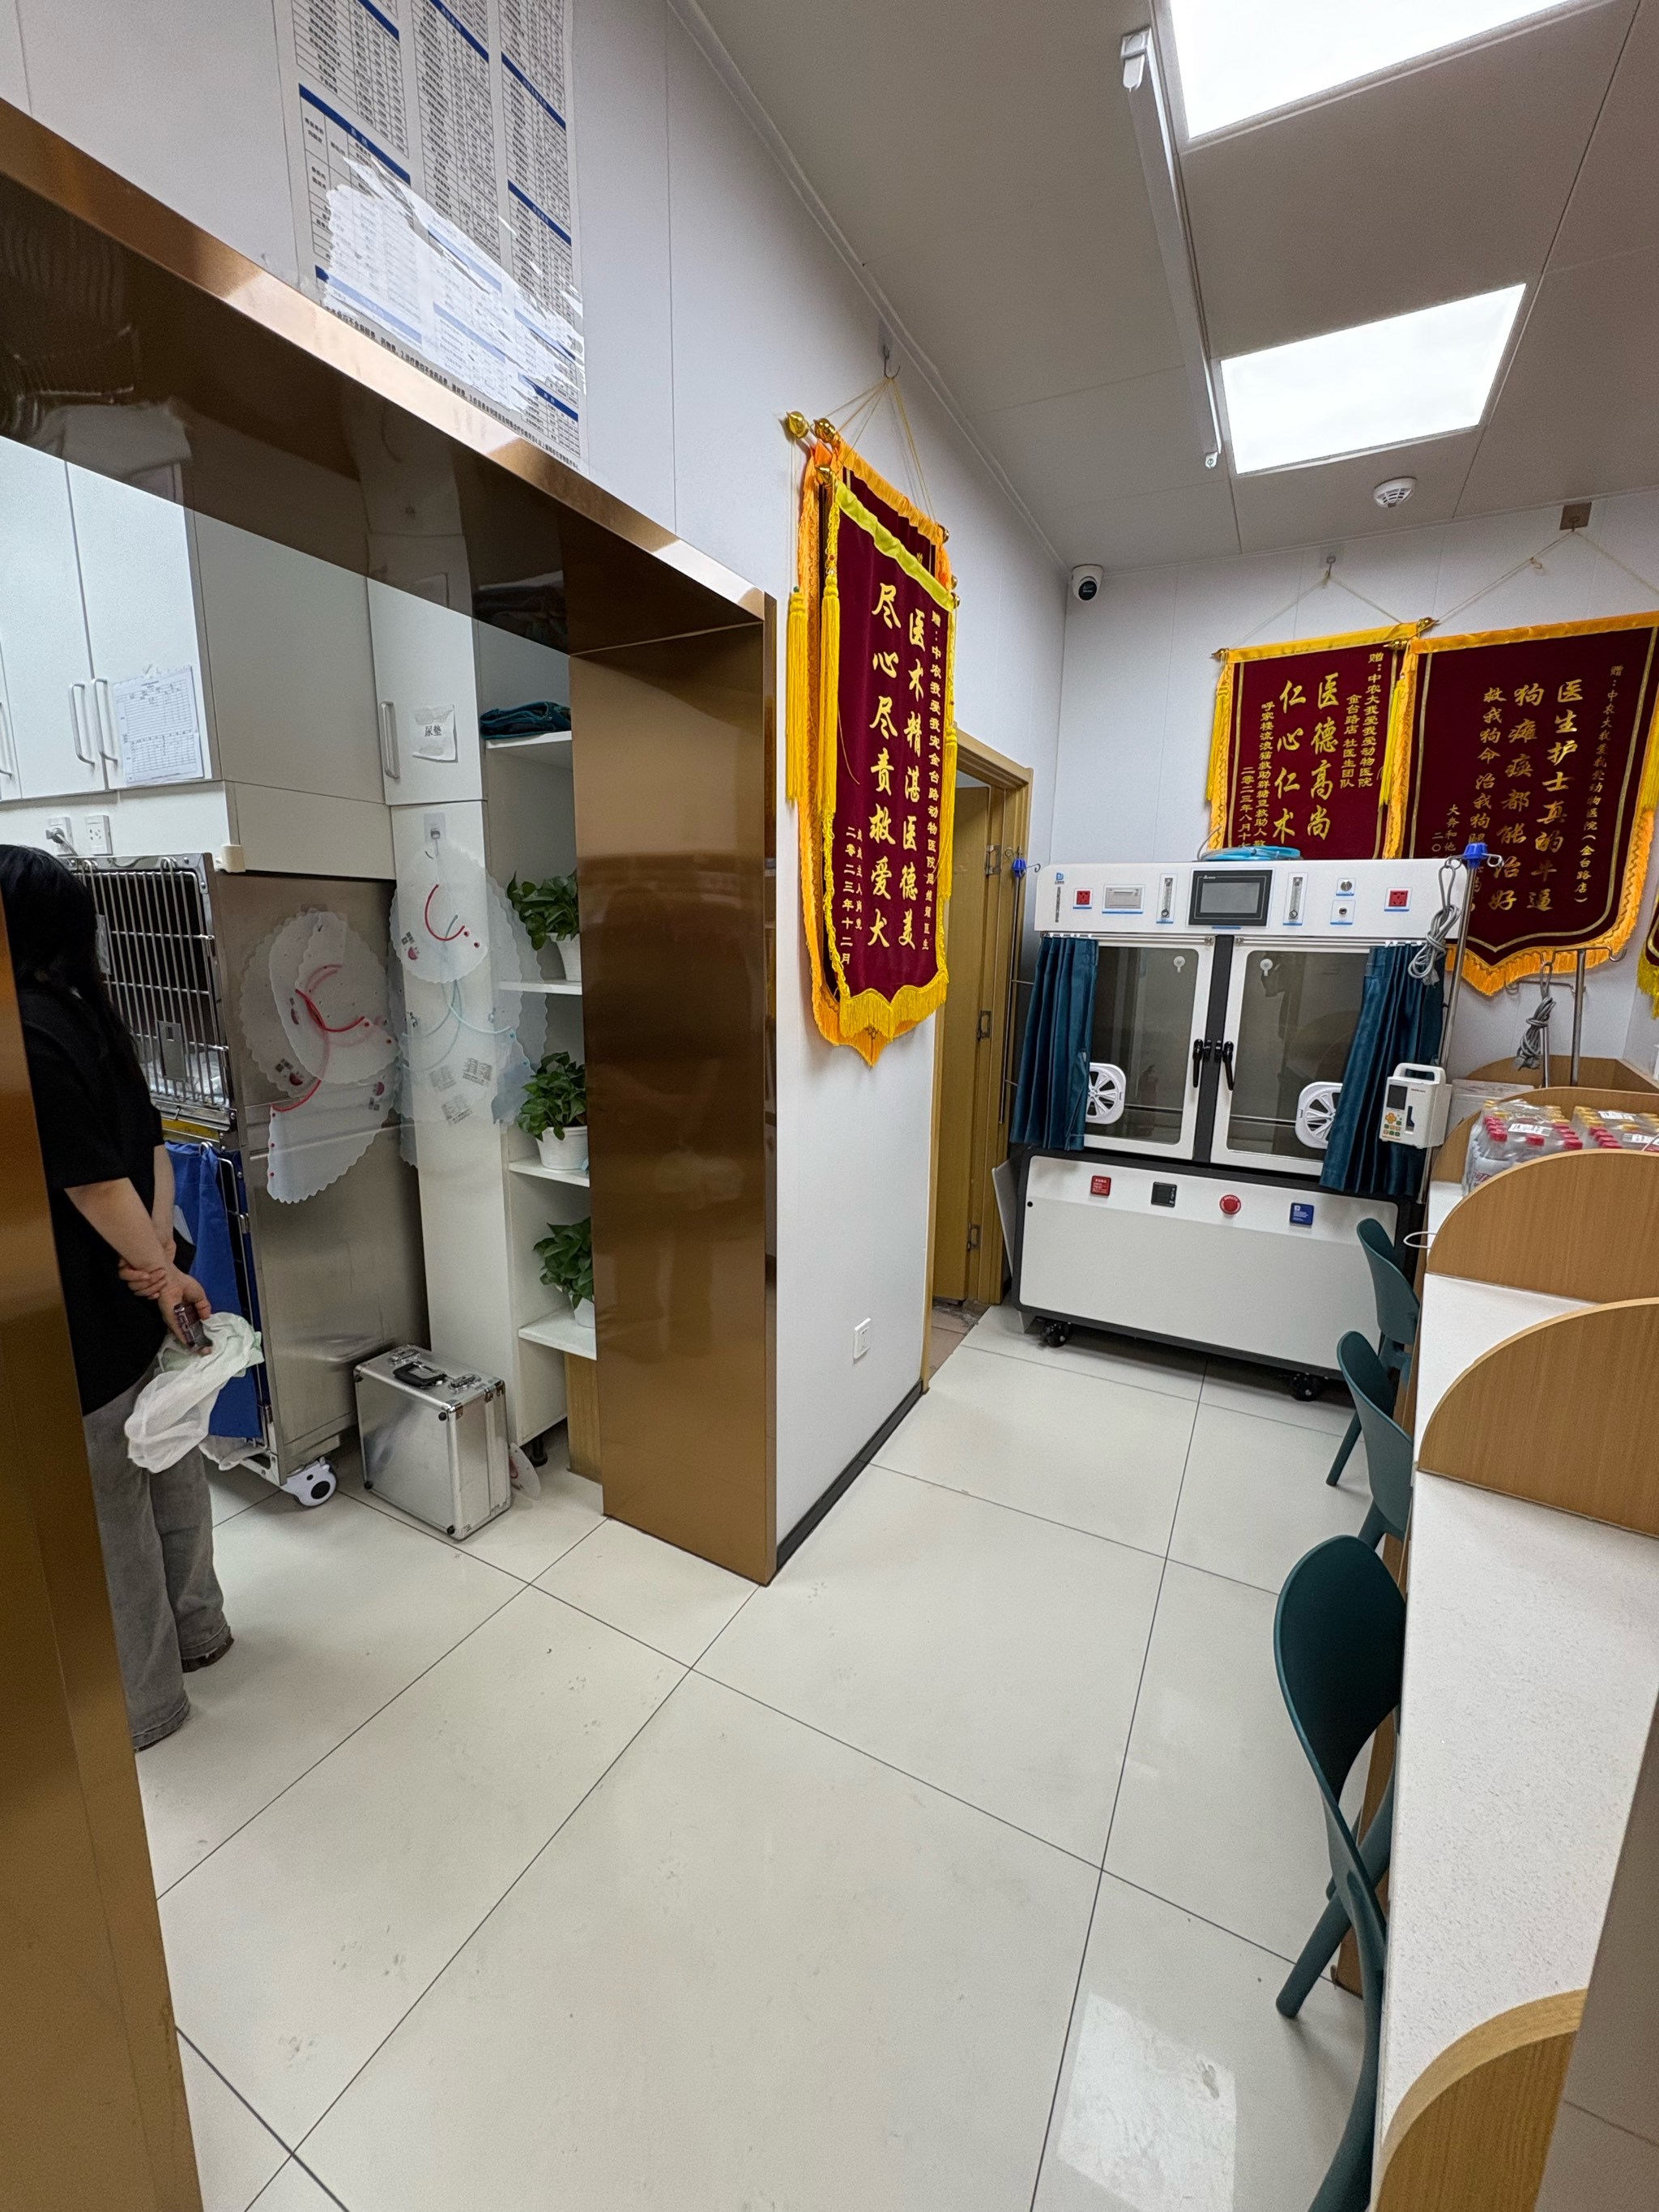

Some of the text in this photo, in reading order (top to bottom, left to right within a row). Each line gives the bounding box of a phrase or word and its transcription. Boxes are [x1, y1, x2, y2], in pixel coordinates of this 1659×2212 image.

[424, 724, 441, 737] 尿垫
[867, 582, 902, 948] 尽心尽责救爱犬
[898, 609, 926, 950] 医术精湛医德美
[1272, 681, 1307, 845] 仁心仁术
[1307, 673, 1339, 840] 医德高尚
[1488, 682, 1546, 911] 狗瘫痪都能治好
[1526, 679, 1584, 912] 医生护士真的牛逼
[840, 826, 857, 966] 二零二三年十二月
